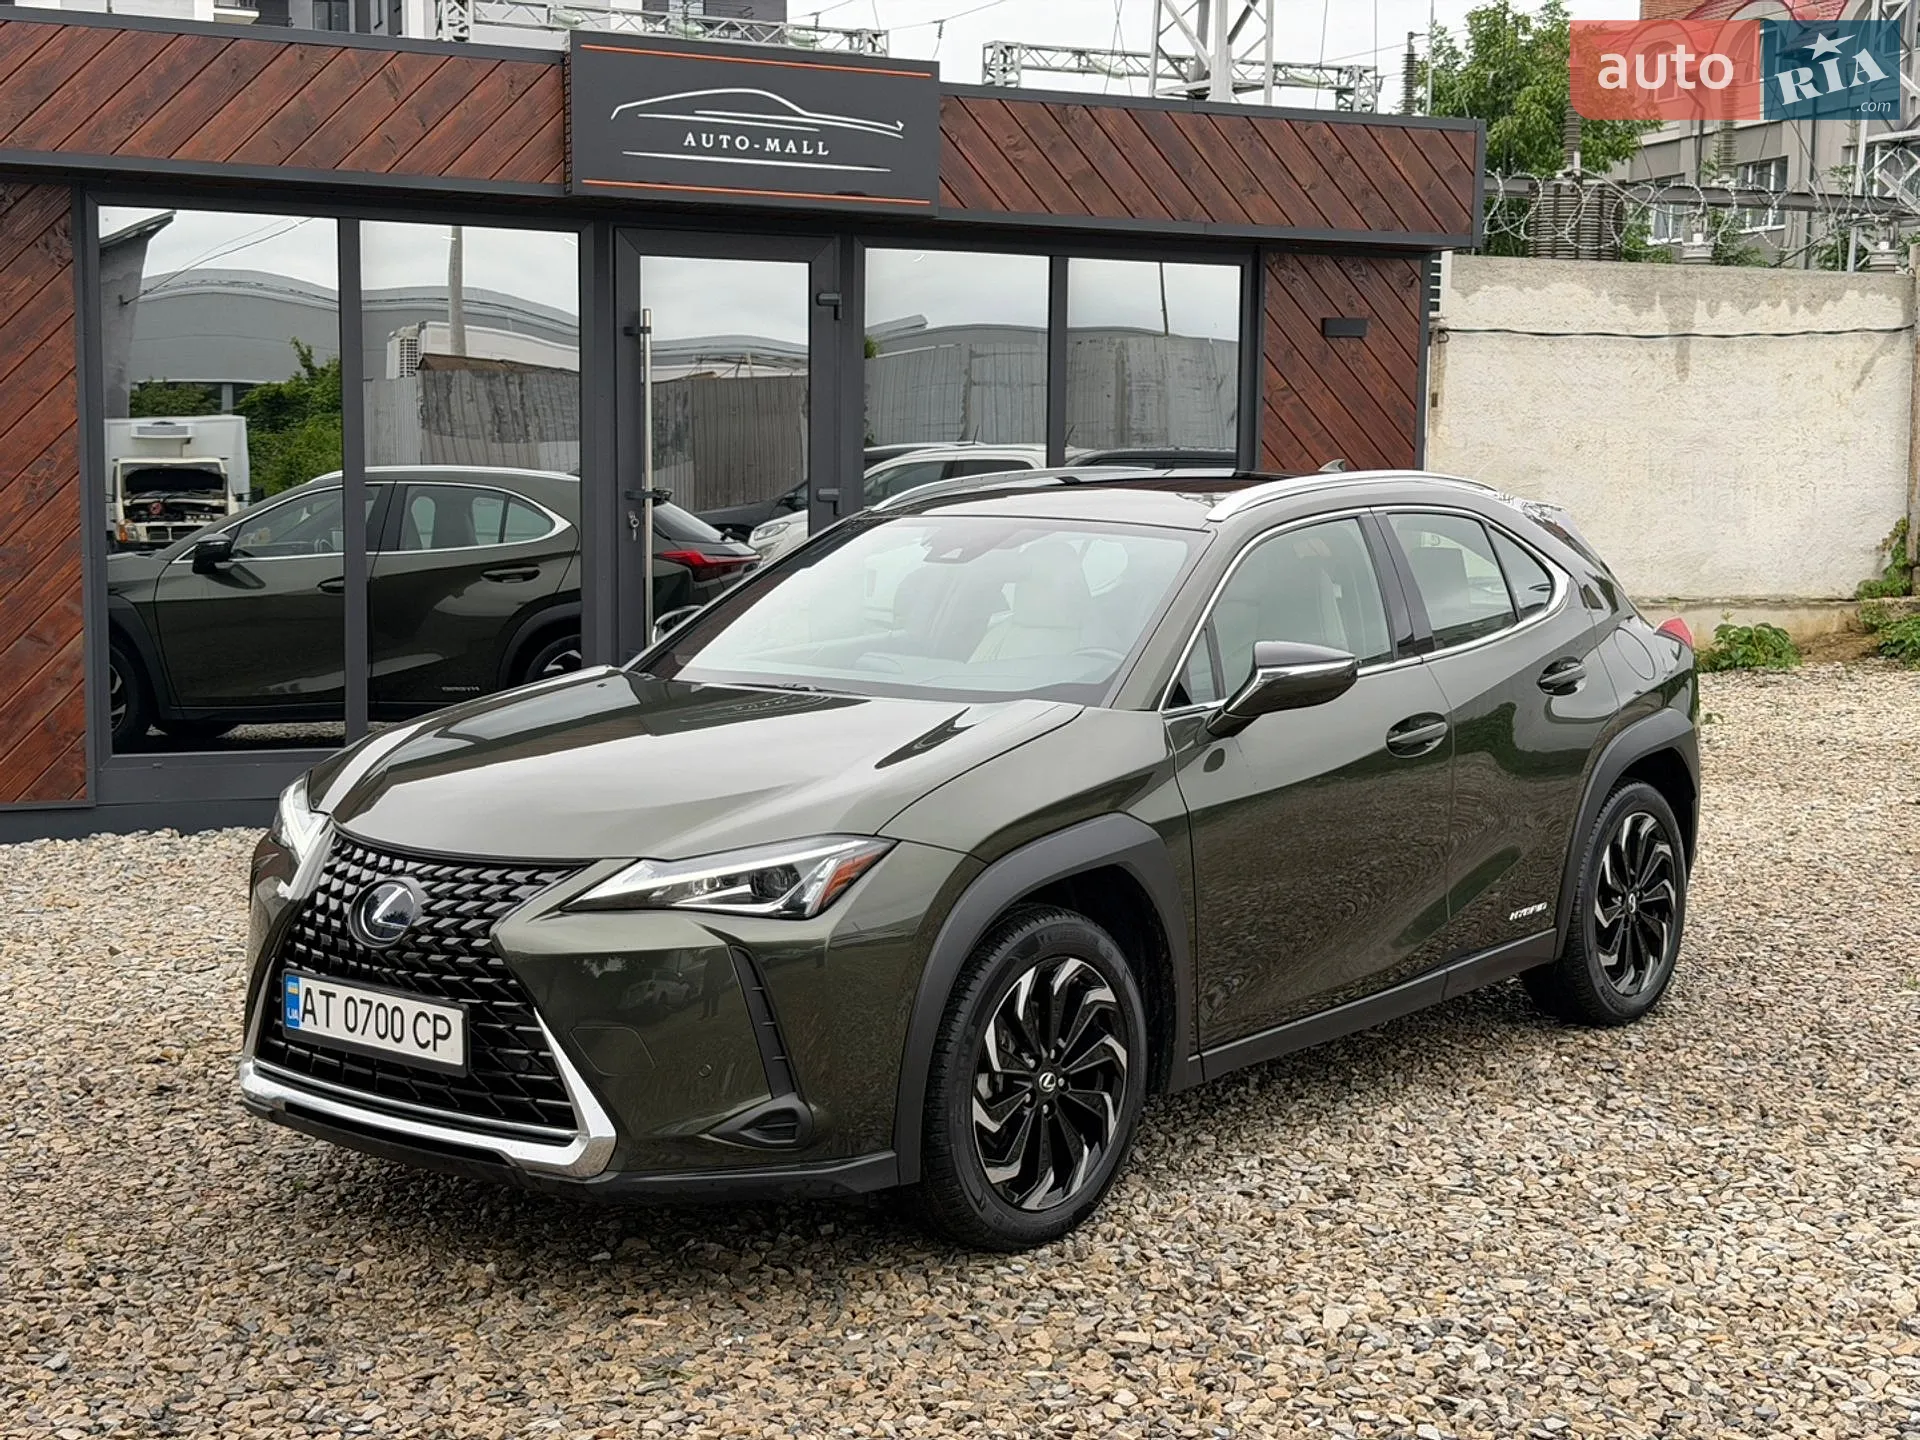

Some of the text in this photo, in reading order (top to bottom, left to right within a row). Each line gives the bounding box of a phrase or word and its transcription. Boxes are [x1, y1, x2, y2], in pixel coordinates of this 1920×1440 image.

[683, 131, 830, 156] AUTO-MALL
[301, 986, 452, 1052] AT 0700 CP
